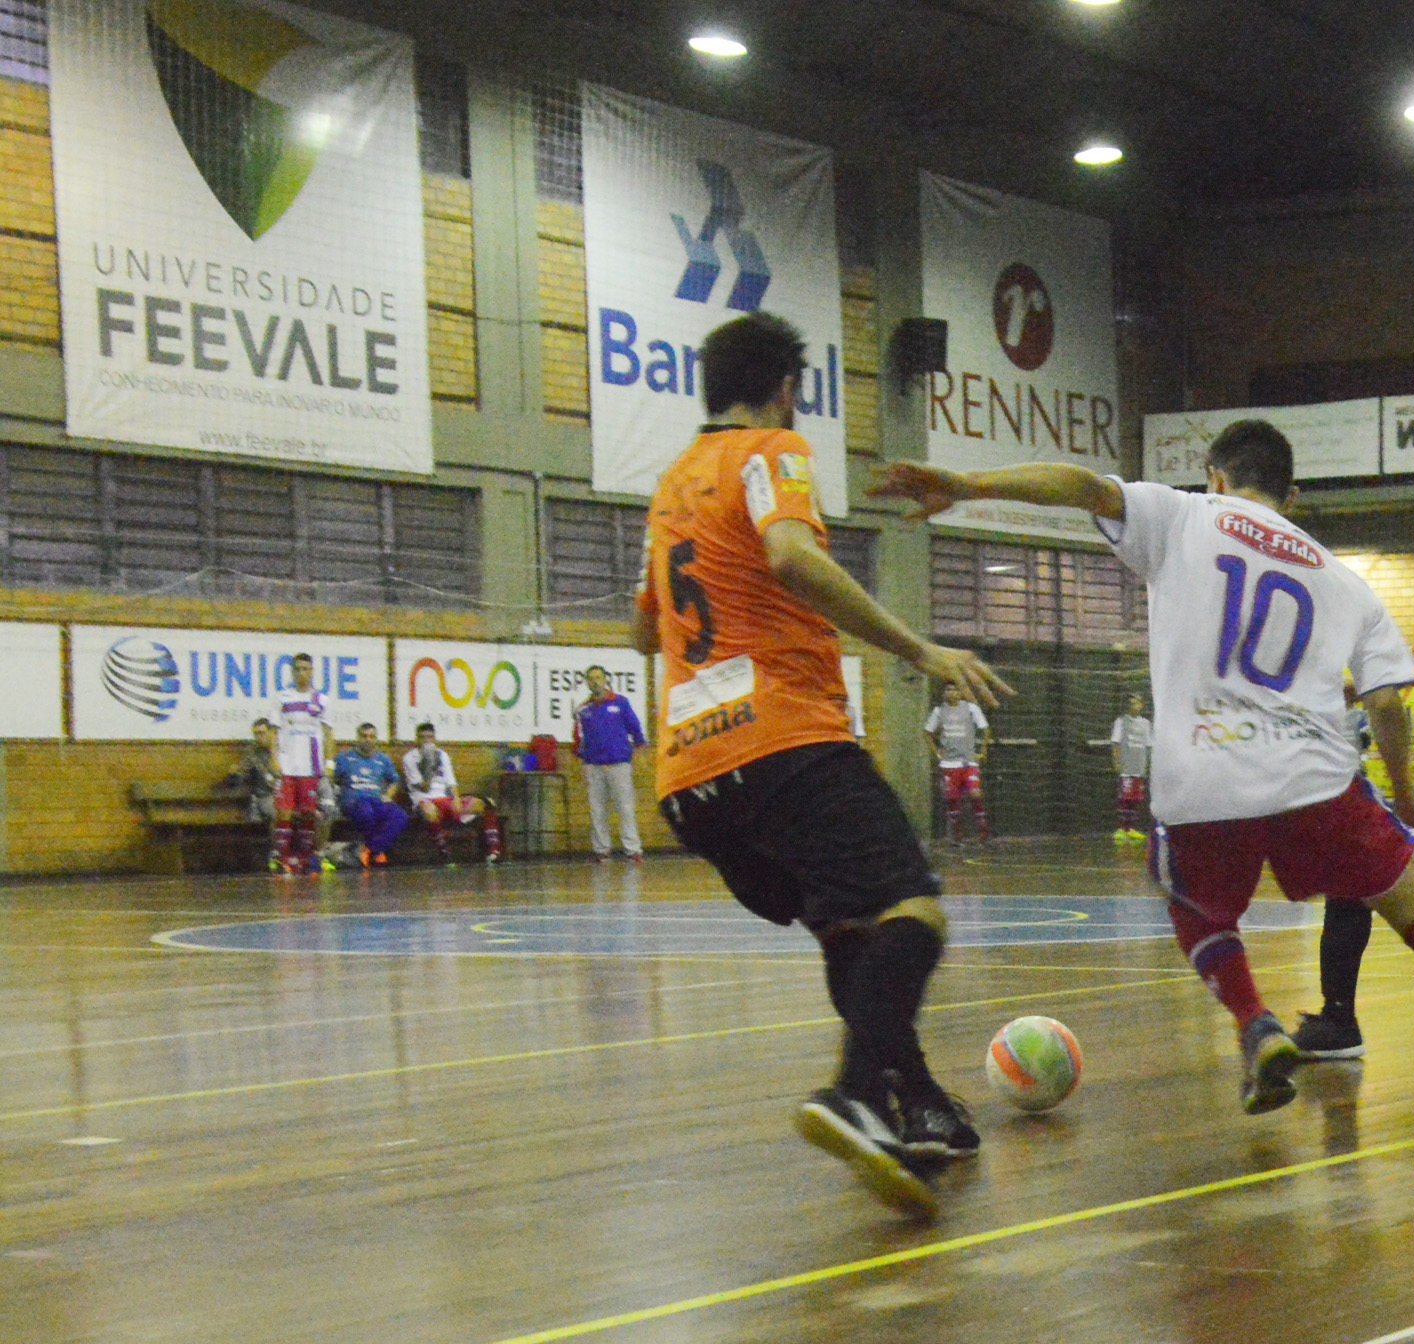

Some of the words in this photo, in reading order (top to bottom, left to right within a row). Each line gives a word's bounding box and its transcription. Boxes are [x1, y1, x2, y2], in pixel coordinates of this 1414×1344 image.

[93, 241, 398, 322] UNIVERSIDADE
[97, 287, 399, 396] FEEVALE
[99, 368, 229, 399] CONHECIMENTO
[233, 386, 275, 407] PARA
[350, 401, 400, 421] MUNDO
[929, 370, 1117, 460] RENNER
[1223, 515, 1265, 541] Fritz
[1271, 534, 1318, 565] Frida
[669, 538, 716, 665] 5
[1215, 553, 1315, 692] 10
[190, 652, 359, 700] UNIQUE
[550, 669, 636, 693] ESPRTE
